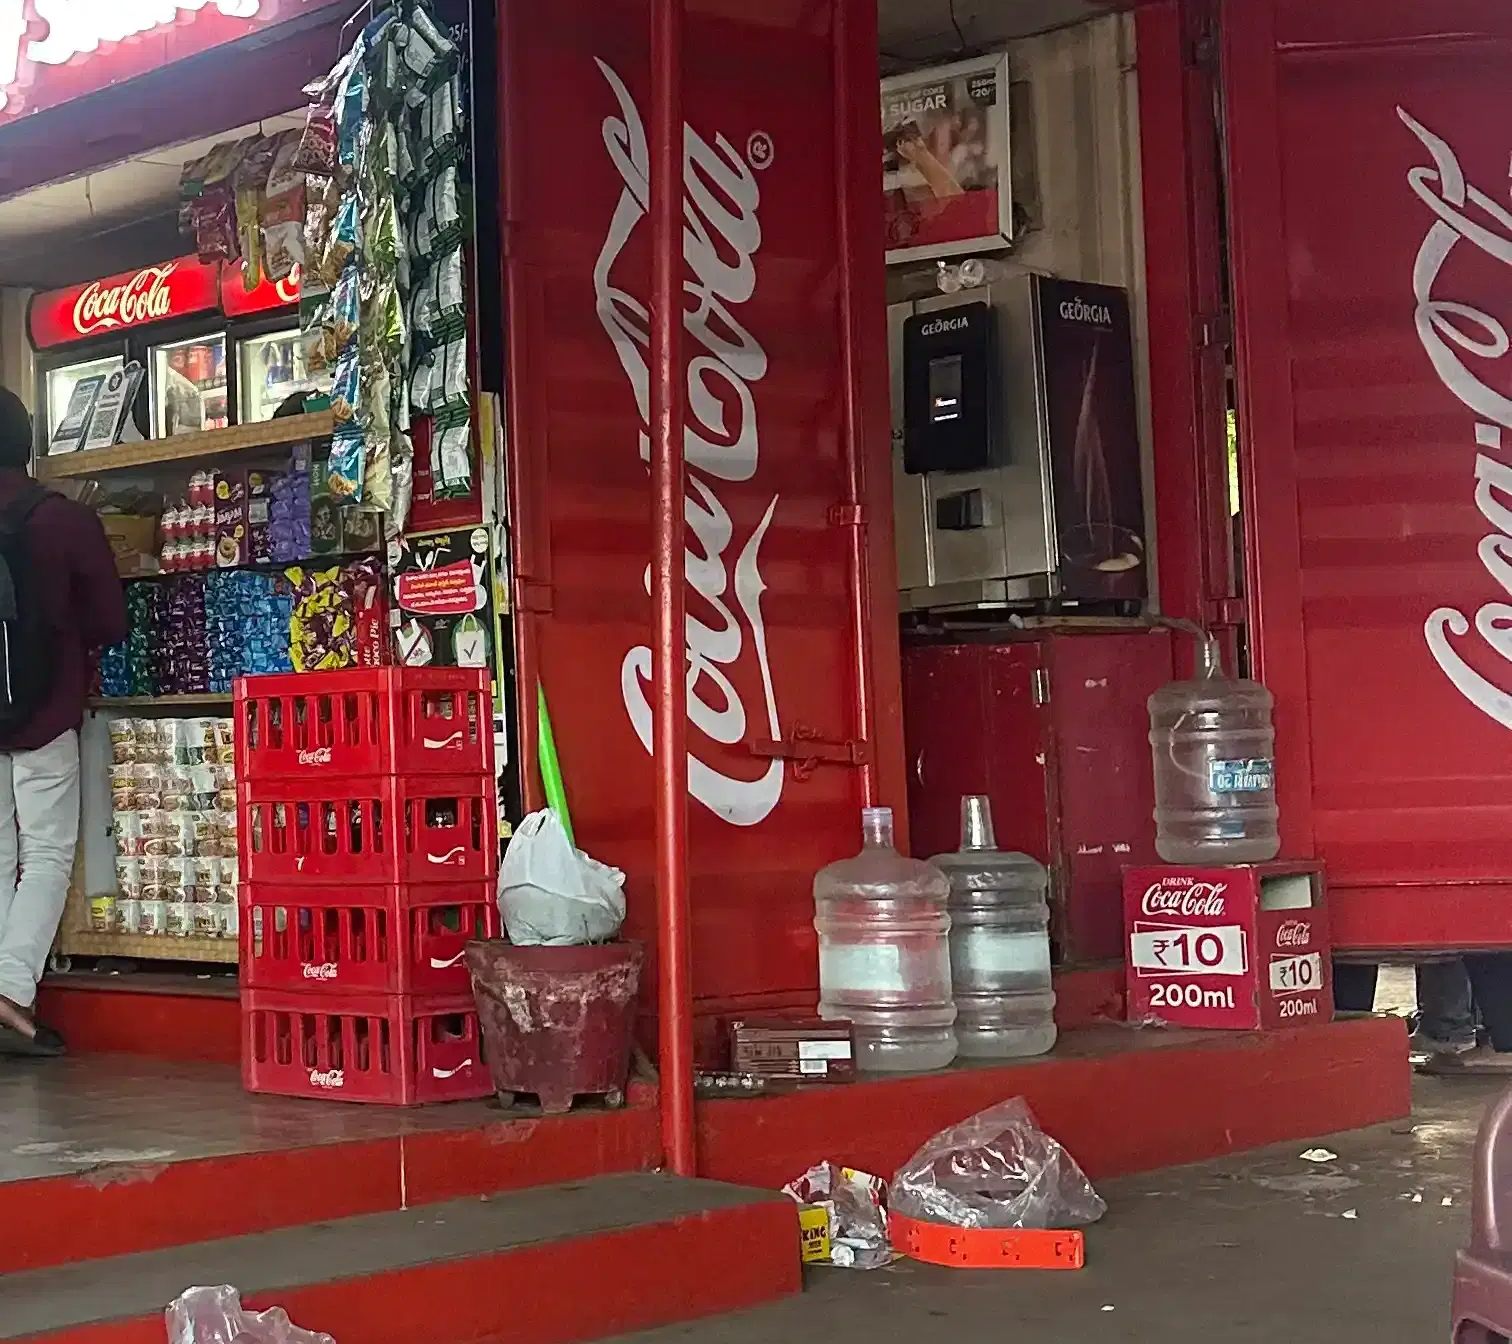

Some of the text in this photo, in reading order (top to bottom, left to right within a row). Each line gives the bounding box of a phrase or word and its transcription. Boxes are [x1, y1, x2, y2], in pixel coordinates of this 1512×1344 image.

[889, 94, 947, 116] SUGAR
[73, 262, 179, 334] Coca-Cola
[1059, 296, 1113, 325] GEORGIA
[921, 316, 969, 336] GEORGIA
[1162, 877, 1194, 886] DRINK
[1141, 882, 1228, 916] Coca-Cola
[1149, 983, 1235, 1009] 200ml
[1279, 998, 1318, 1018] 200ml
[802, 1225, 827, 1242] KING
